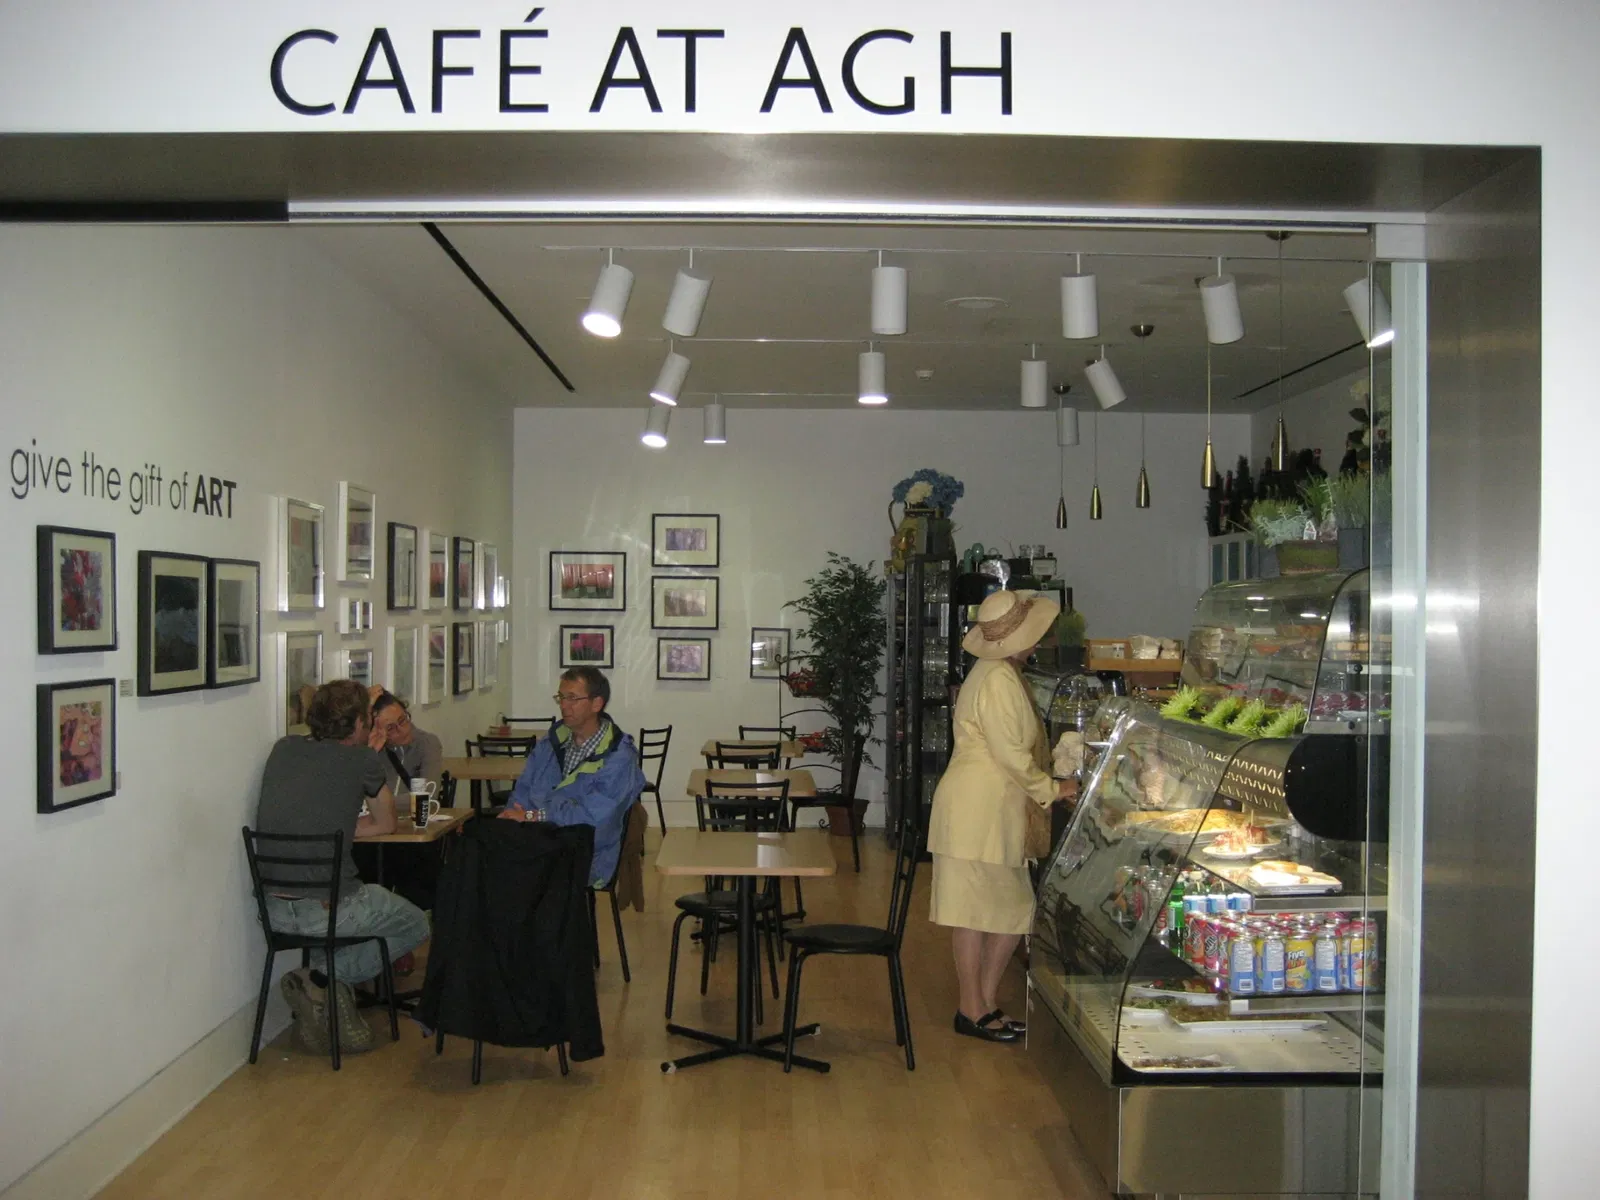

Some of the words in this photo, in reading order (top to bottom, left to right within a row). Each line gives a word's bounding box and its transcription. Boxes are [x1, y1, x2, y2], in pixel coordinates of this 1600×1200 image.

[270, 7, 549, 116] CAFÉ
[589, 26, 725, 113] AT
[760, 27, 1013, 116] AGH
[10, 438, 72, 500] give
[81, 451, 121, 501] the
[129, 463, 163, 515] gift
[169, 471, 189, 511] of
[192, 474, 237, 519] ART
